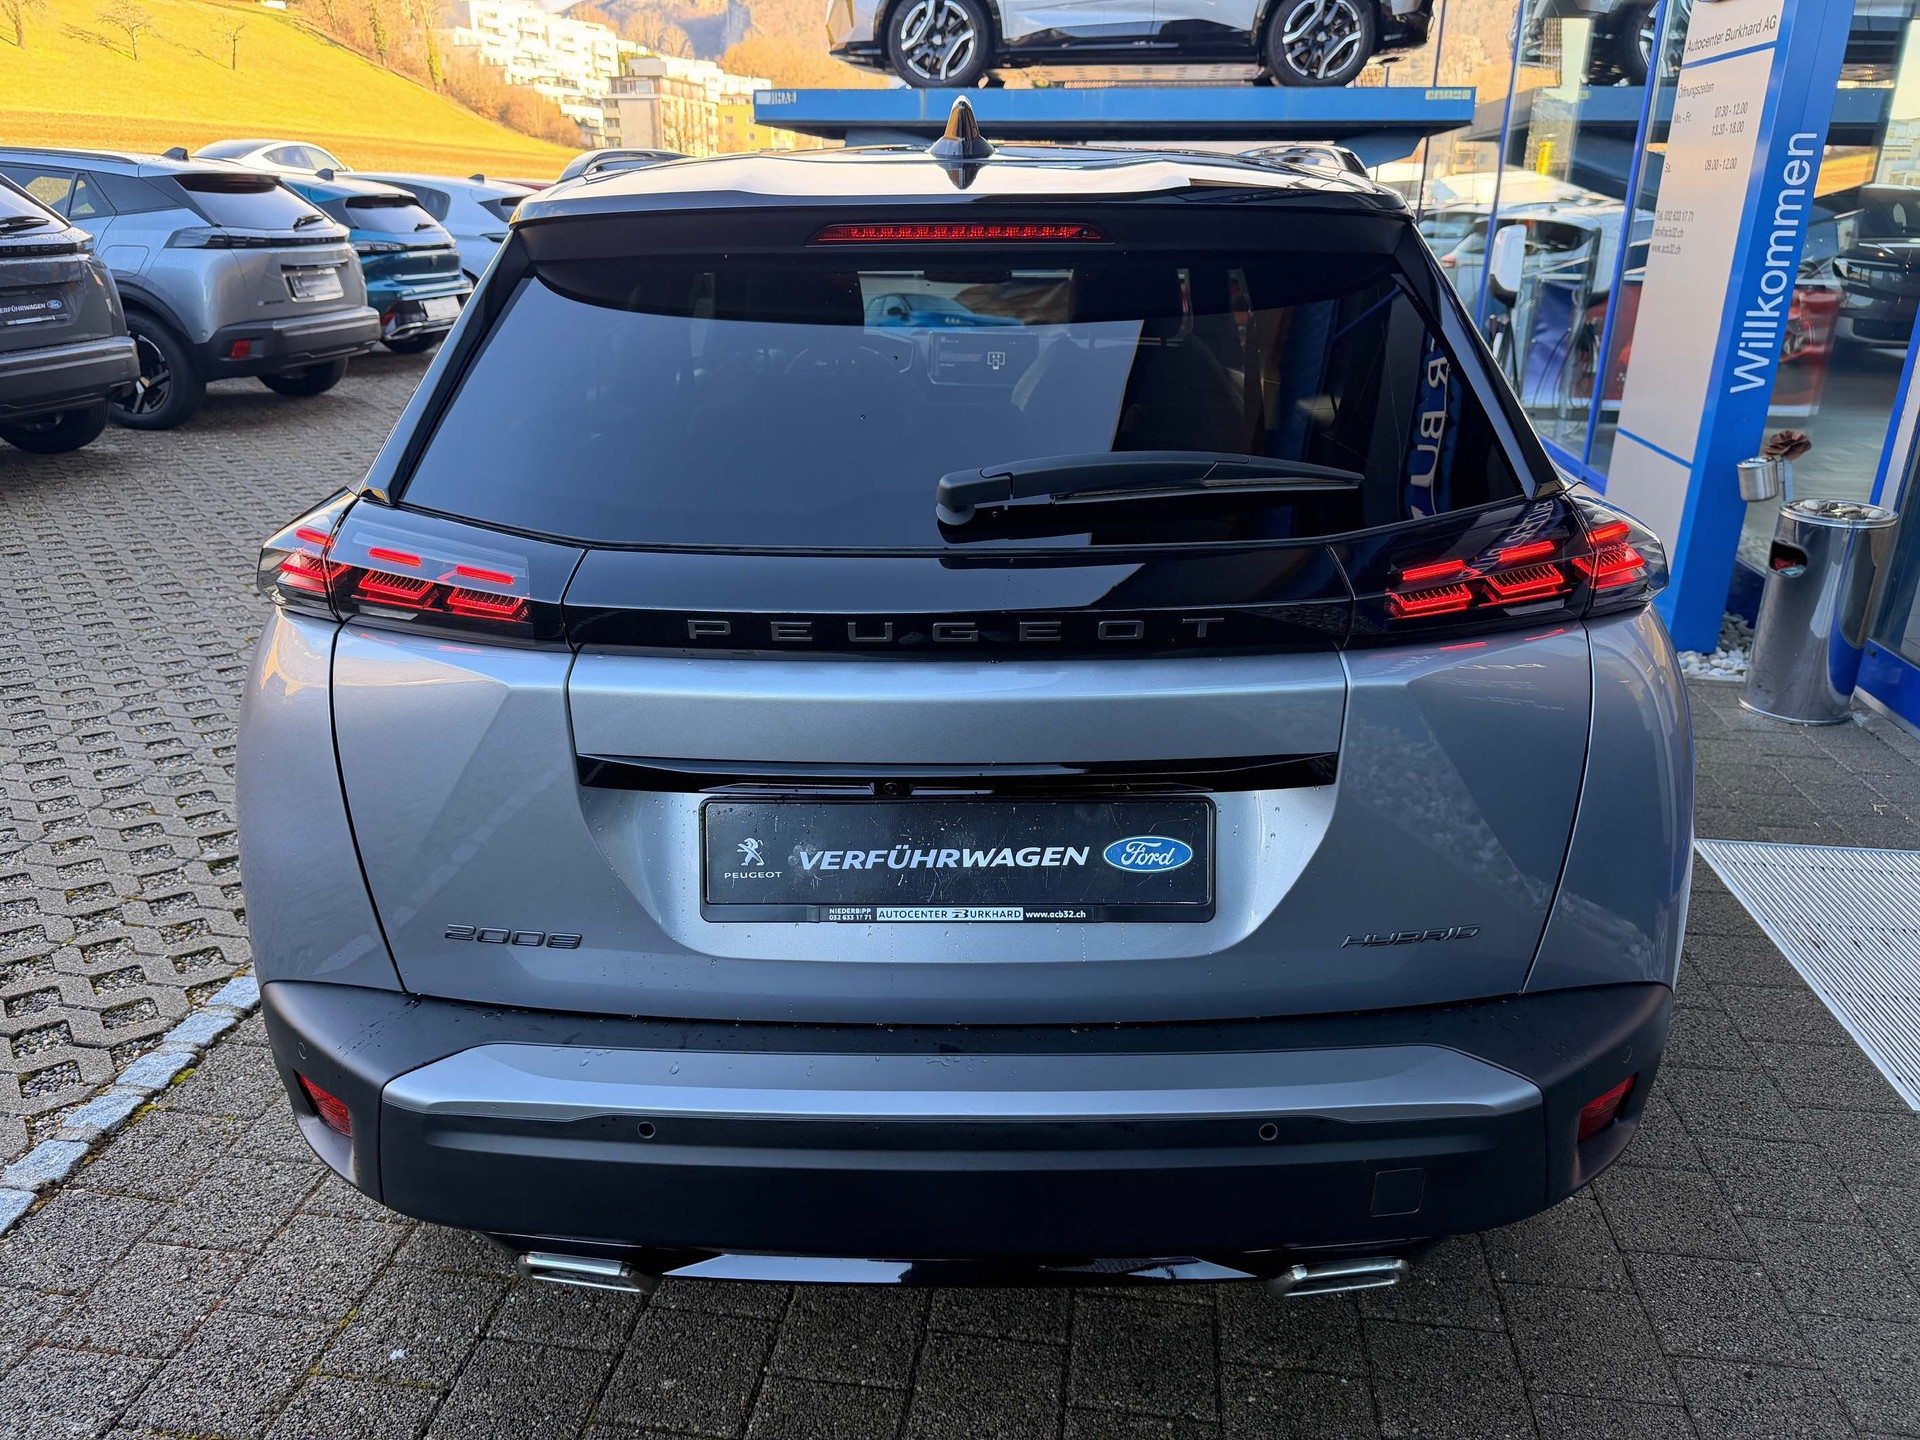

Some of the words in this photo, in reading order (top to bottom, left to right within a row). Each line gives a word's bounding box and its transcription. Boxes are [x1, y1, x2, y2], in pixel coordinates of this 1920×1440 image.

[1686, 32, 1724, 53] Autocenter
[1724, 19, 1763, 42] Burkhard
[1762, 14, 1777, 32] AG
[1732, 101, 1749, 116] 12.00
[1704, 158, 1719, 171] 09.00
[1722, 157, 1738, 170] 12.00
[1729, 132, 1818, 394] Willkommen
[687, 617, 1225, 643] PEUGEOT
[800, 845, 1091, 870] VERFÜHRWAGEN
[724, 871, 782, 879] PEUGEOT
[878, 910, 948, 918] AUTOCENTER
[1025, 910, 1086, 918] www.acb32.ch
[445, 924, 582, 949] 2008
[1340, 924, 1481, 949] HYBRID
